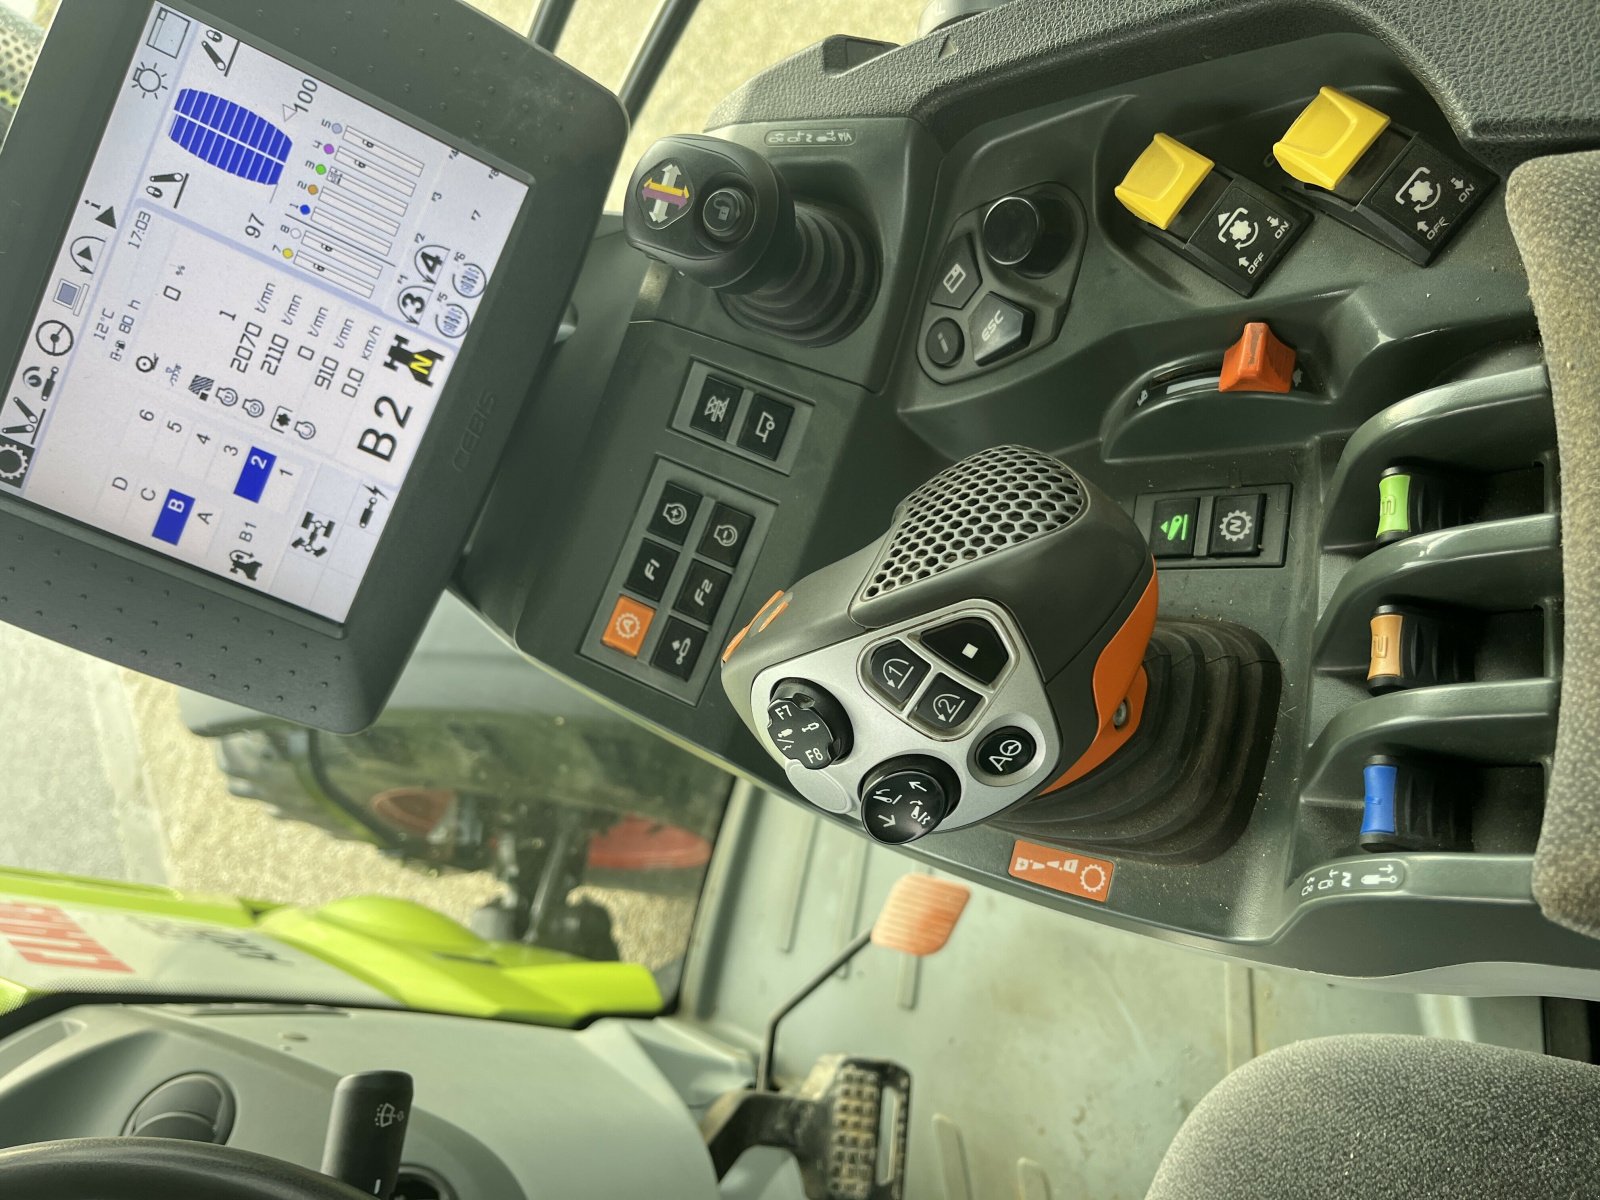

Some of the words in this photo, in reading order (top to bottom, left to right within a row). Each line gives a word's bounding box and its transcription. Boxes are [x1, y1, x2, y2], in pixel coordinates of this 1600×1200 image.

[292, 77, 319, 115] 100
[320, 118, 331, 128] 5
[312, 139, 323, 150] 4
[304, 159, 315, 169] 3
[296, 179, 307, 190] 2
[1457, 182, 1476, 203] ON
[288, 201, 299, 209] 1
[127, 210, 151, 250] 17:03
[243, 212, 266, 240] 97
[279, 224, 290, 234] 8
[271, 243, 282, 254] 7
[1246, 251, 1266, 276] OFF
[1273, 219, 1290, 239] ON
[415, 249, 444, 275] 4
[399, 289, 427, 315] 3
[117, 313, 134, 335] 80
[127, 297, 141, 310] h
[218, 307, 236, 321] 1
[978, 308, 1006, 342] ESC
[229, 320, 262, 374] 2070
[260, 332, 289, 376] 2110
[296, 344, 315, 361] 0
[313, 354, 340, 390] 910
[408, 352, 434, 376] N
[340, 366, 365, 399] 0.0
[137, 407, 155, 423] 6
[166, 418, 183, 434] 5
[194, 430, 211, 446] 4
[222, 442, 239, 458] 3
[248, 452, 269, 471] 2
[277, 466, 294, 479] 1
[111, 474, 130, 492] D
[138, 485, 157, 503] C
[167, 496, 186, 514] B
[194, 507, 213, 525] A
[237, 519, 257, 544] B1
[1229, 519, 1241, 532] N
[641, 556, 662, 581] F1
[691, 576, 714, 606] F2
[772, 702, 794, 721] F7
[935, 696, 957, 715] 2
[802, 747, 825, 764] F8
